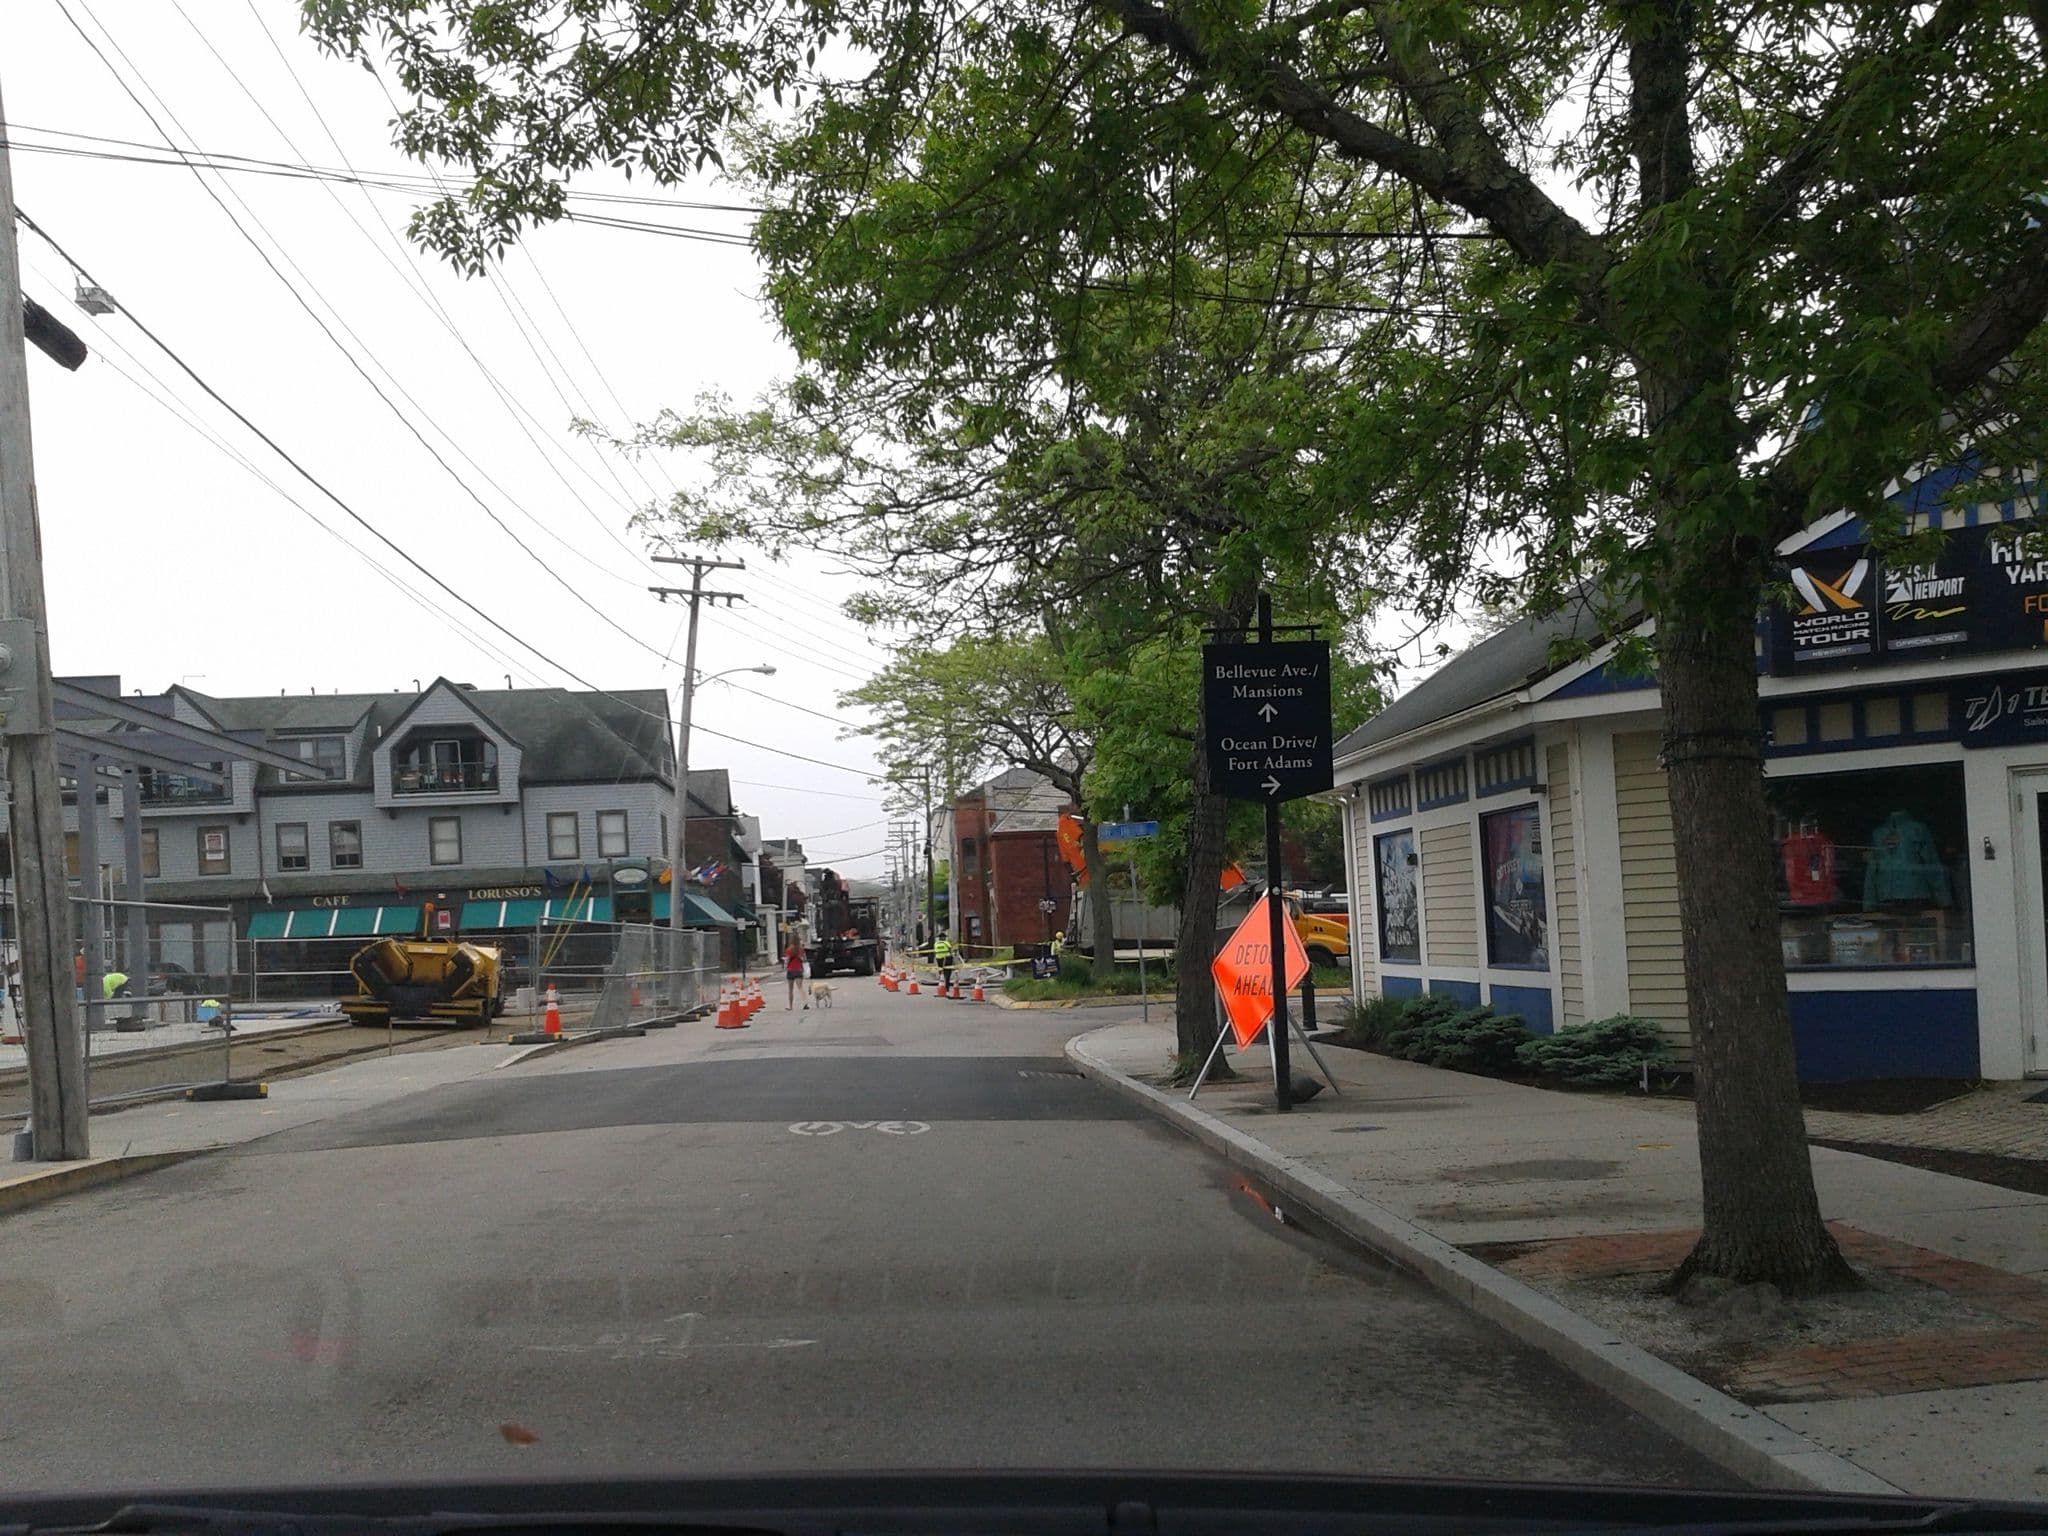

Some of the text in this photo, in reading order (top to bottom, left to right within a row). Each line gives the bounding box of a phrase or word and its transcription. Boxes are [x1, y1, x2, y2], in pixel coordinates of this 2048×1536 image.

[1914, 577, 1965, 600] NEWPORT
[1793, 611, 1870, 628] WORLD
[1793, 621, 1870, 635] MATCH RACING
[1793, 628, 1871, 646] TOUR
[1895, 634, 1959, 647] OFFICIAL HOST
[1812, 647, 1852, 657] NEWPORT
[1216, 664, 1319, 679] Bellevue Ave./
[1232, 685, 1303, 699] Mansions
[1221, 735, 1318, 751] Ocean Drive/
[1228, 756, 1313, 771] Fort Adams
[312, 895, 351, 907] CAFE
[468, 887, 542, 900] LORUSSO'S
[1235, 943, 1286, 965] DETO
